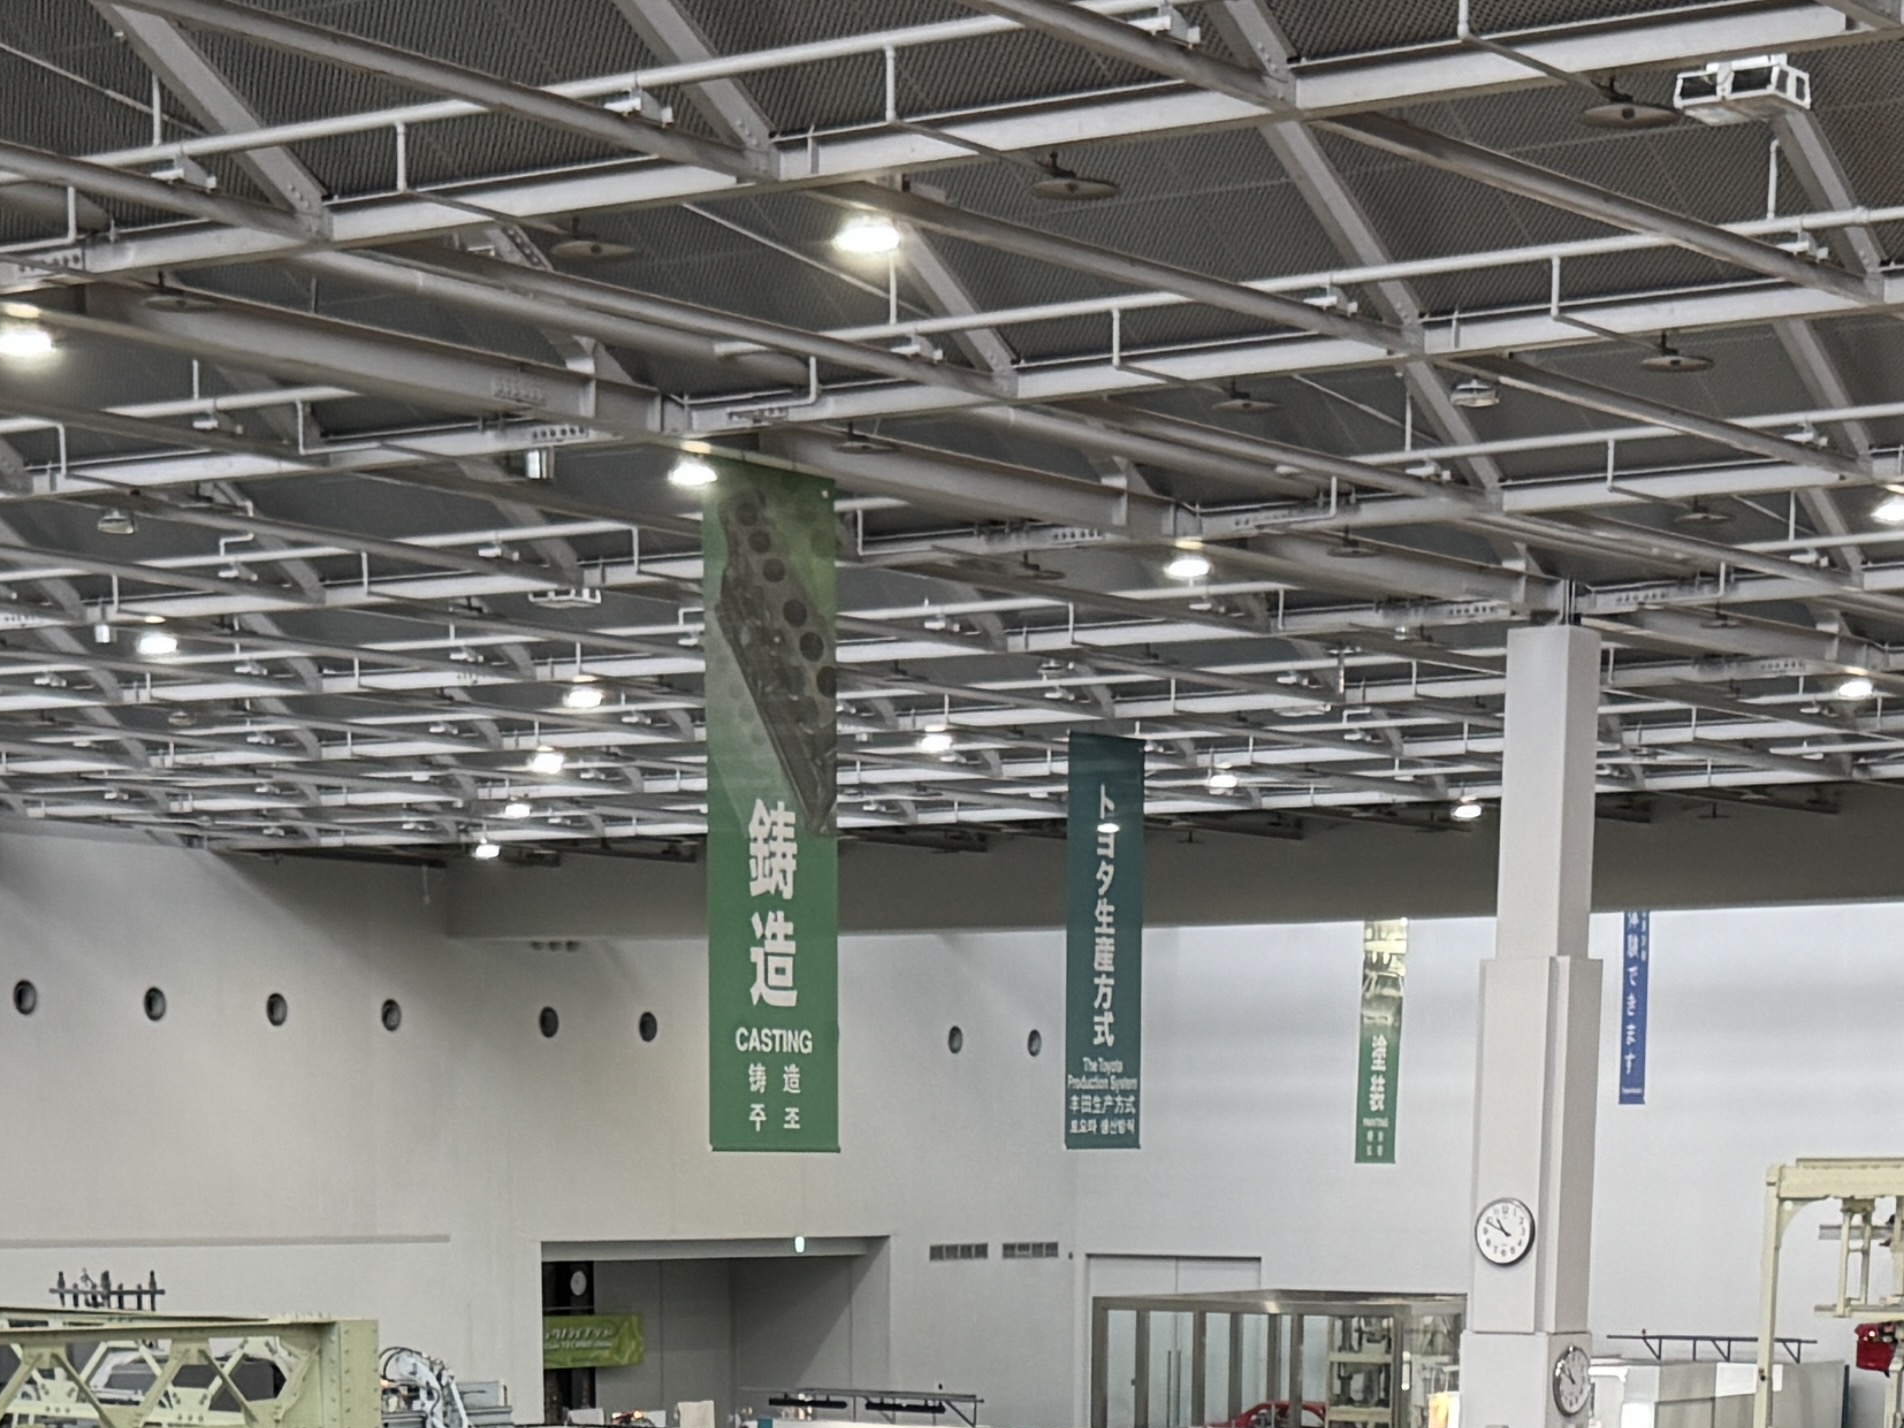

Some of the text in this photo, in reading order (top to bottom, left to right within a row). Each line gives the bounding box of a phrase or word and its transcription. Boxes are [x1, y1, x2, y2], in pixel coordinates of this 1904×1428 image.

[1092, 784, 1117, 1048] トヨタ生産方式
[735, 1026, 813, 1056] CASTING
